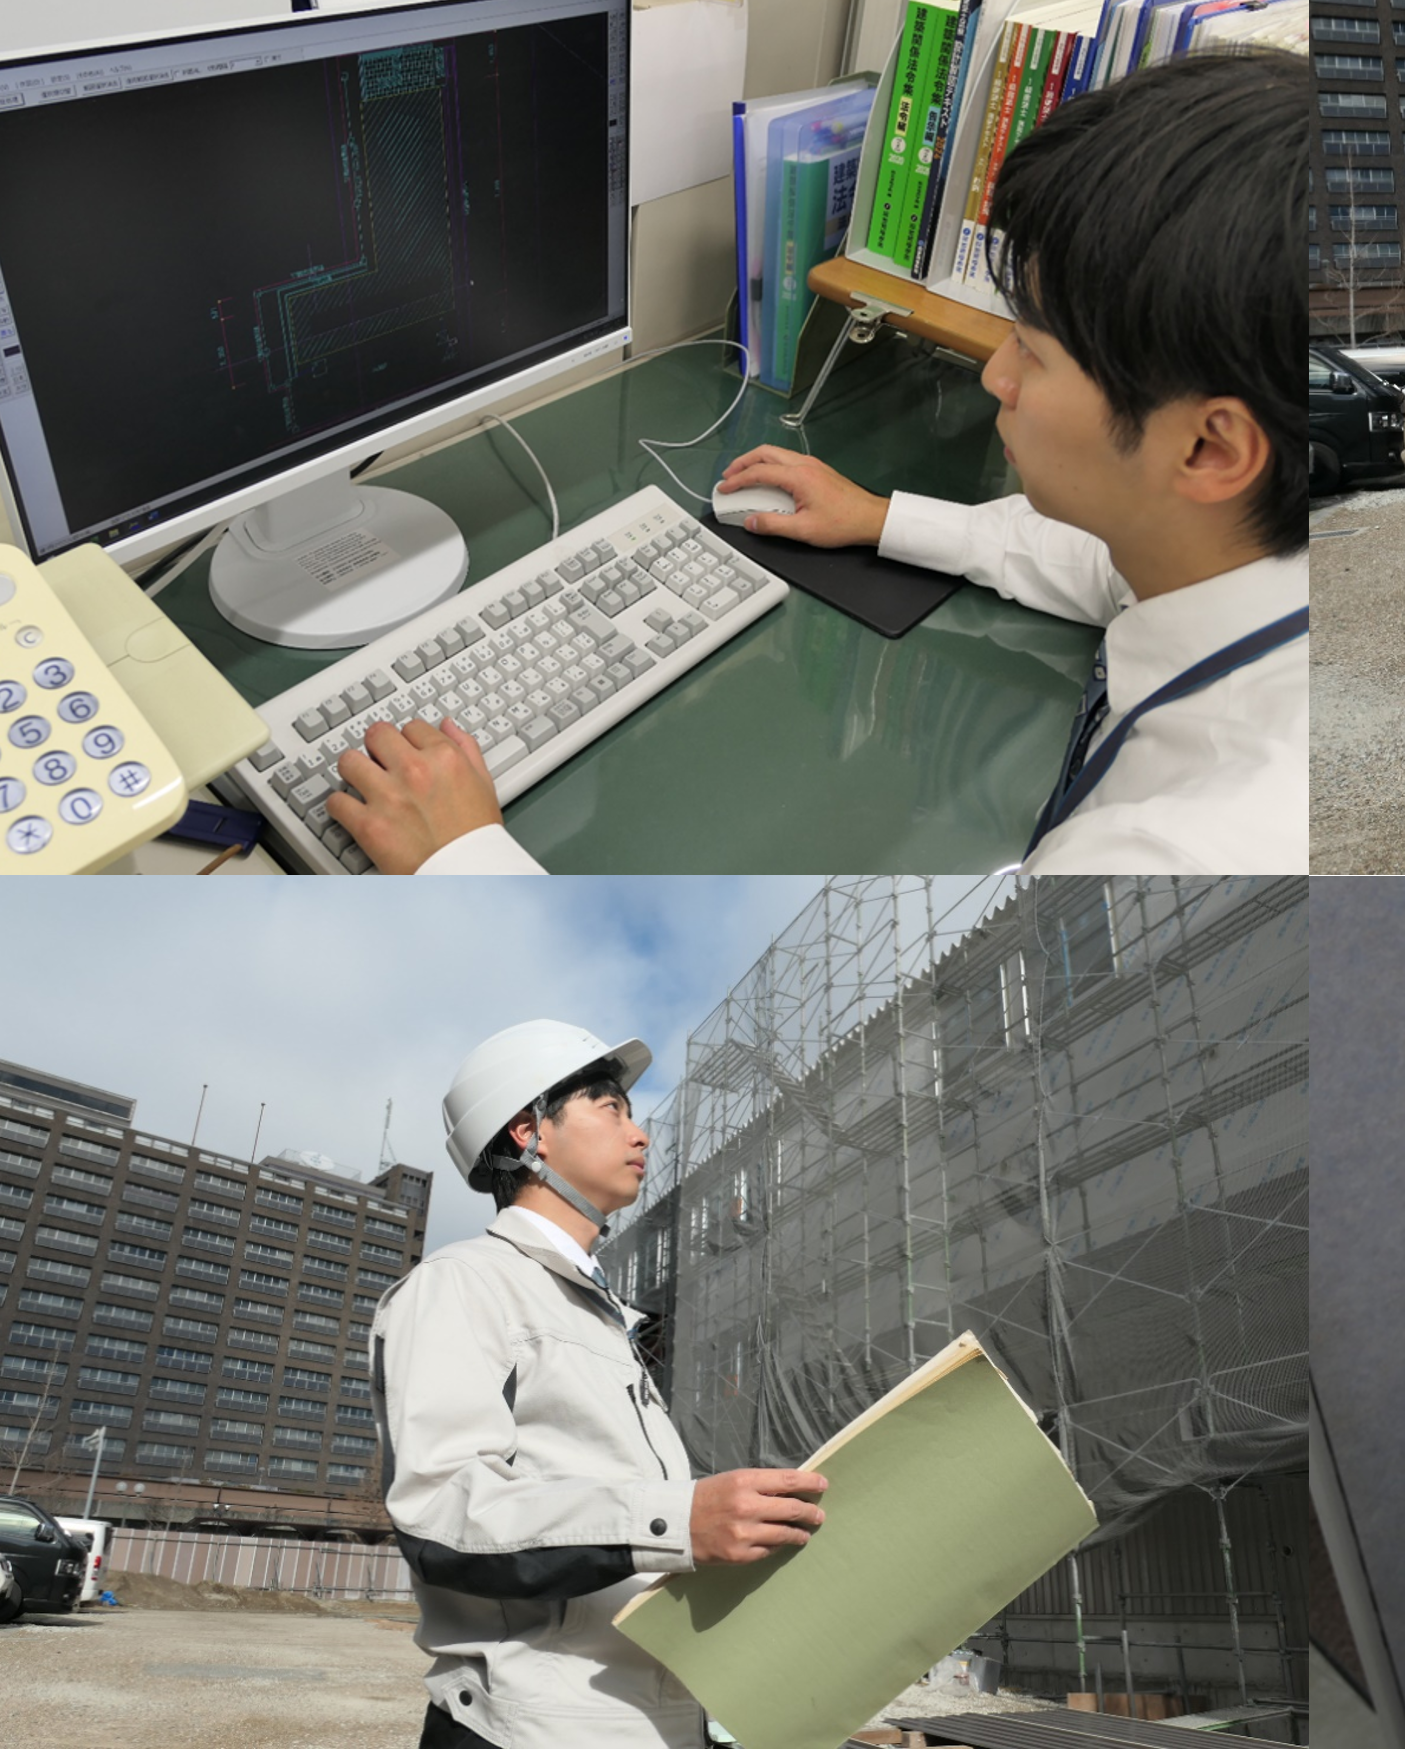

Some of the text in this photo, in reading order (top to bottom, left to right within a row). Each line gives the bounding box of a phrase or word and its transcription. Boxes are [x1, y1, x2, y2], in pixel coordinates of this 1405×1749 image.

[23, 631, 36, 644] C
[0, 664, 68, 711] 2 3
[19, 697, 92, 745] 5 6
[44, 757, 68, 782] 8
[93, 732, 117, 756] 9
[69, 796, 94, 821] 0
